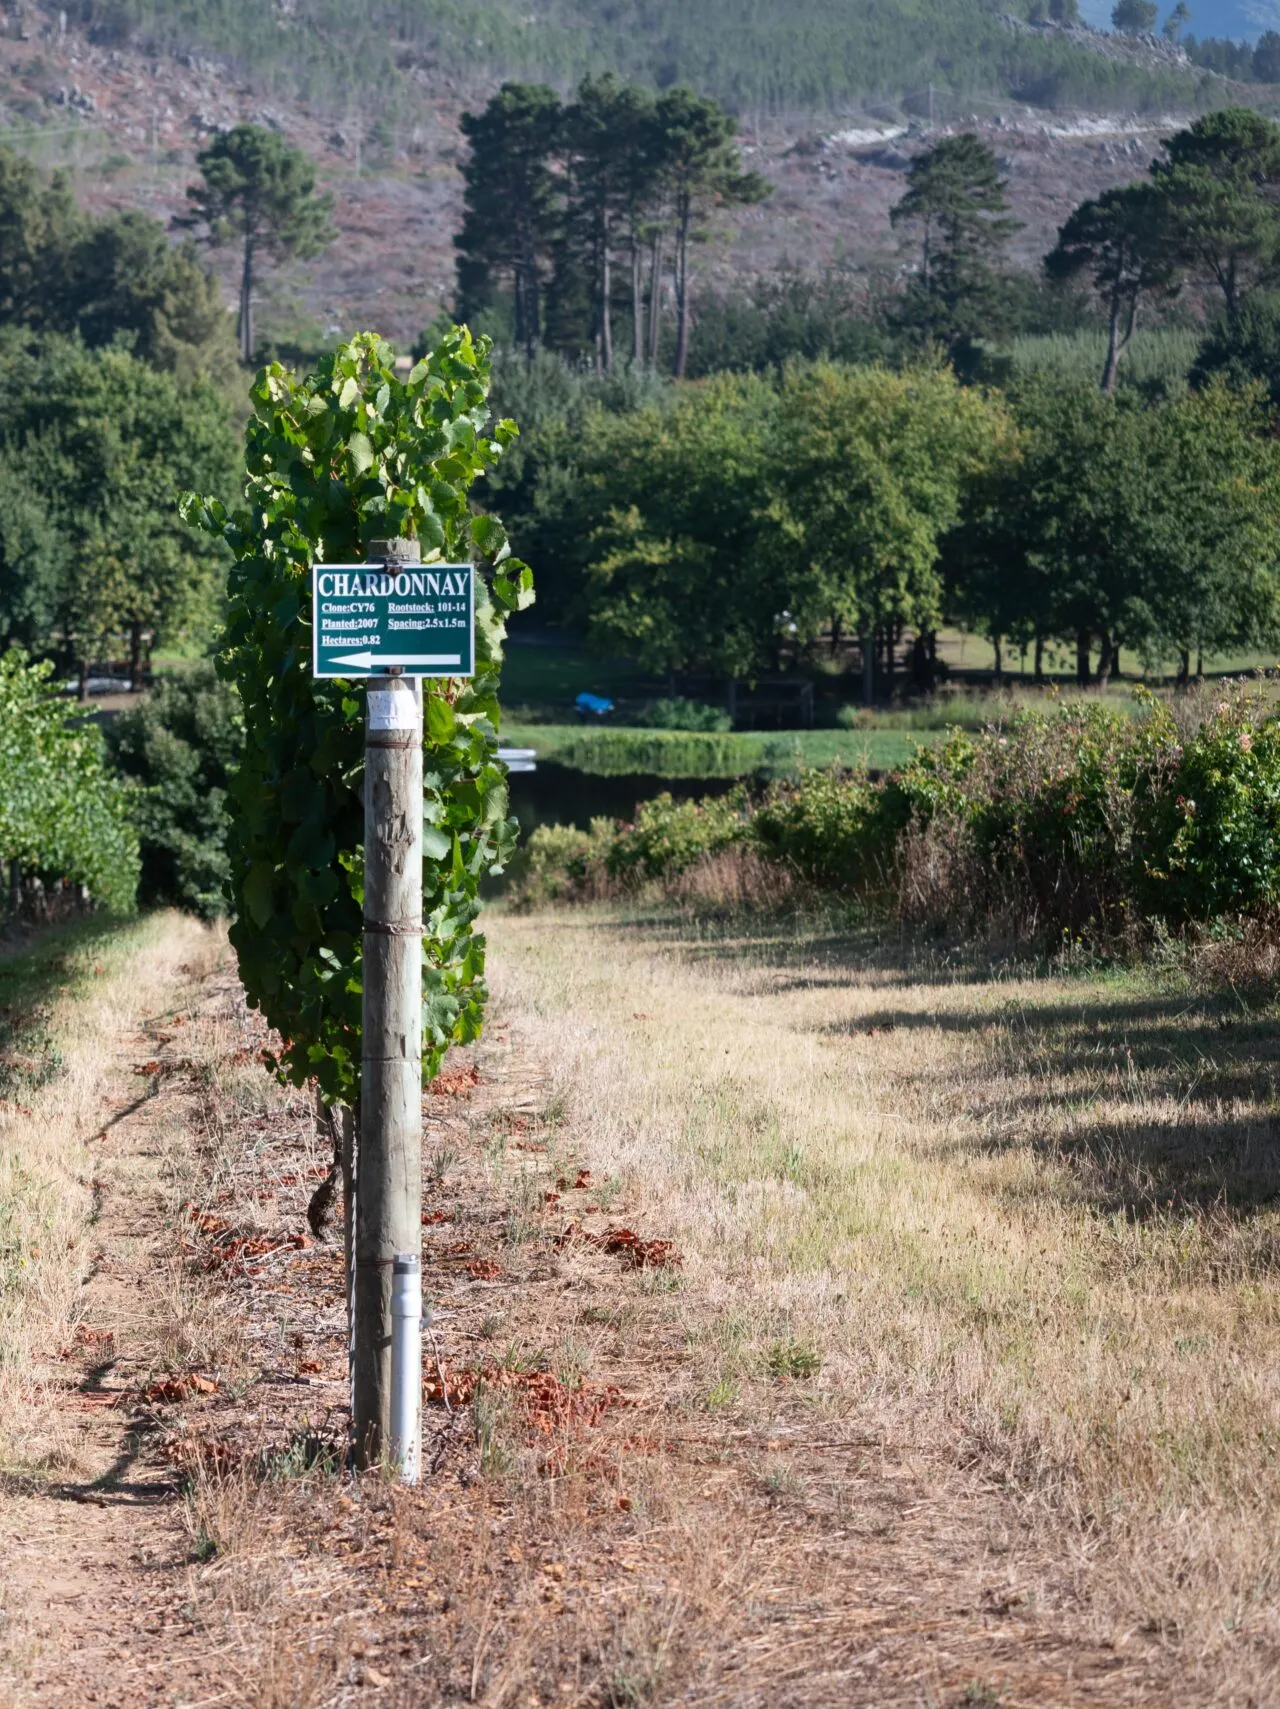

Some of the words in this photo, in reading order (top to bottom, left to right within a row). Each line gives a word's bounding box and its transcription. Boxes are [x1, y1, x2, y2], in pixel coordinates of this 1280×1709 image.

[319, 573, 468, 597] CHARDONNAY
[388, 602, 435, 613] Rootstock:
[437, 602, 466, 612] 101-14
